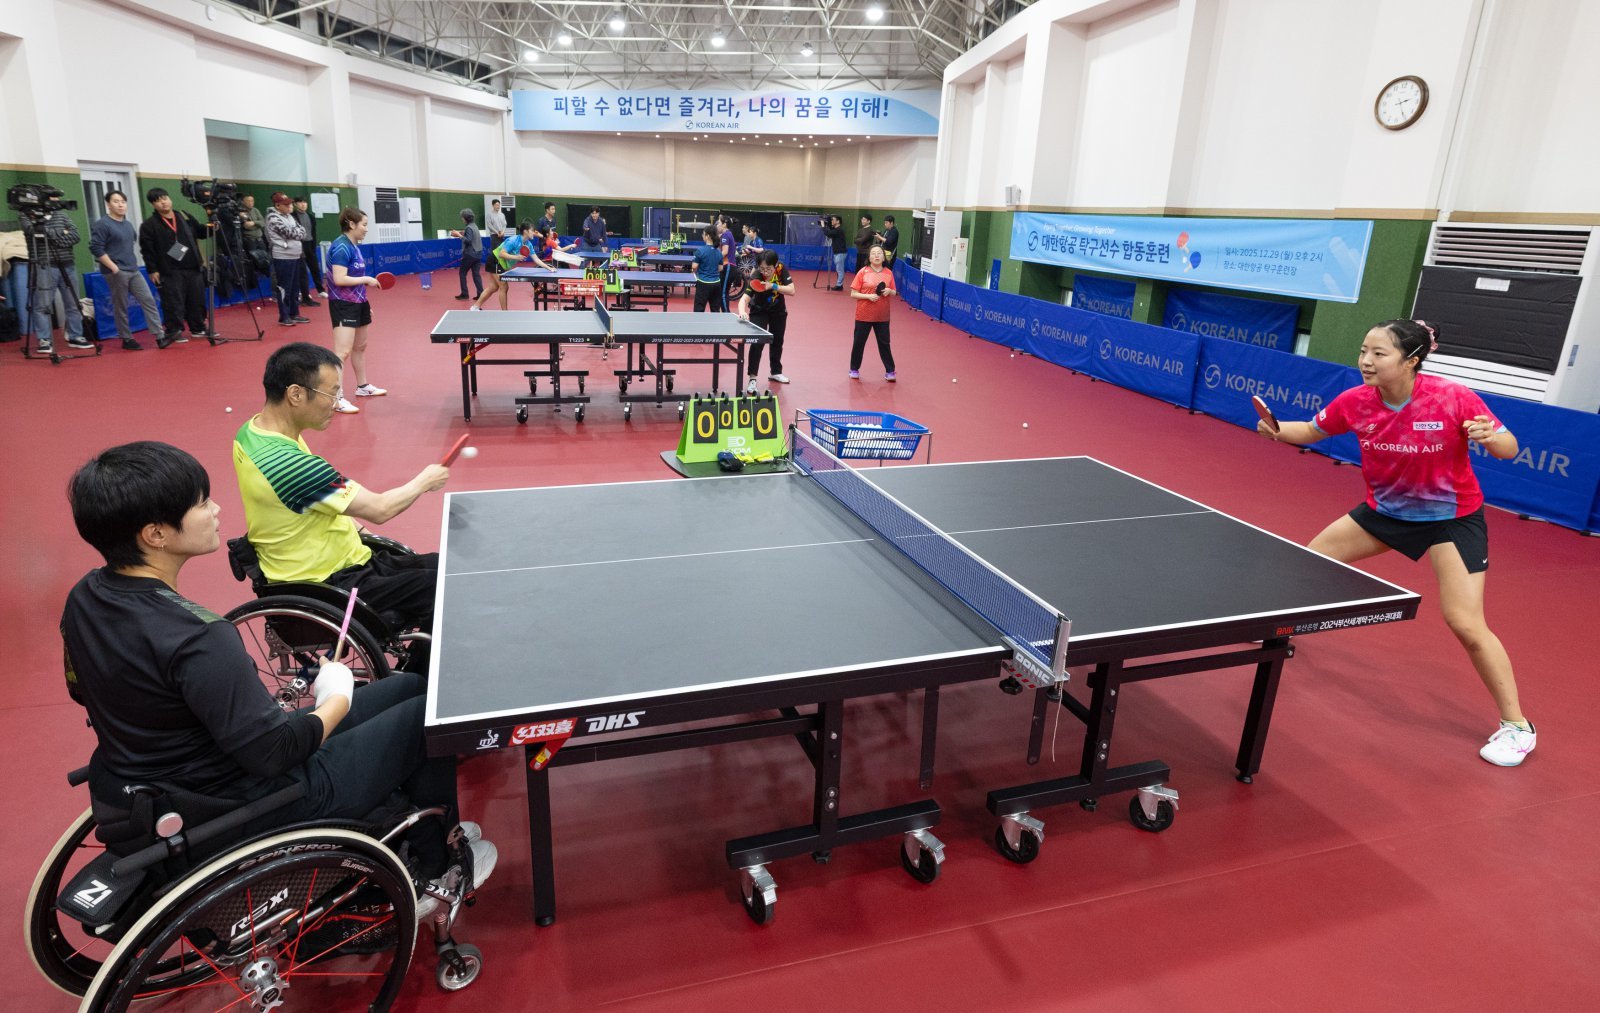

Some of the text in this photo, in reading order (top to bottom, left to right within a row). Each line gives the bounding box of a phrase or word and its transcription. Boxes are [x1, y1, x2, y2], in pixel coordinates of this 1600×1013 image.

[553, 96, 889, 119] 피할 수 없다면 즐겨라, 나의 꿈을 위해!
[1041, 233, 1171, 264] 대한항공 탁구선수 합동훈련
[608, 273, 614, 283] 1
[984, 309, 1026, 329] KOREAN AIR
[1088, 299, 1124, 317] KOREAN
[1041, 323, 1088, 349] KOREAN AIR
[1190, 320, 1279, 349] KOREAN AIR
[1114, 345, 1184, 377] KOREAN AIR
[1225, 372, 1323, 412] KOREAN AIR
[697, 408, 773, 438] 0 0 0 0
[1373, 442, 1444, 454] KOREAN AIR
[1512, 446, 1571, 478] AIR
[1276, 625, 1294, 636] BNK
[1295, 622, 1319, 633] 부산은행
[1014, 652, 1050, 684] DONIC
[585, 710, 646, 733] DHS
[76, 879, 113, 906] Z1
